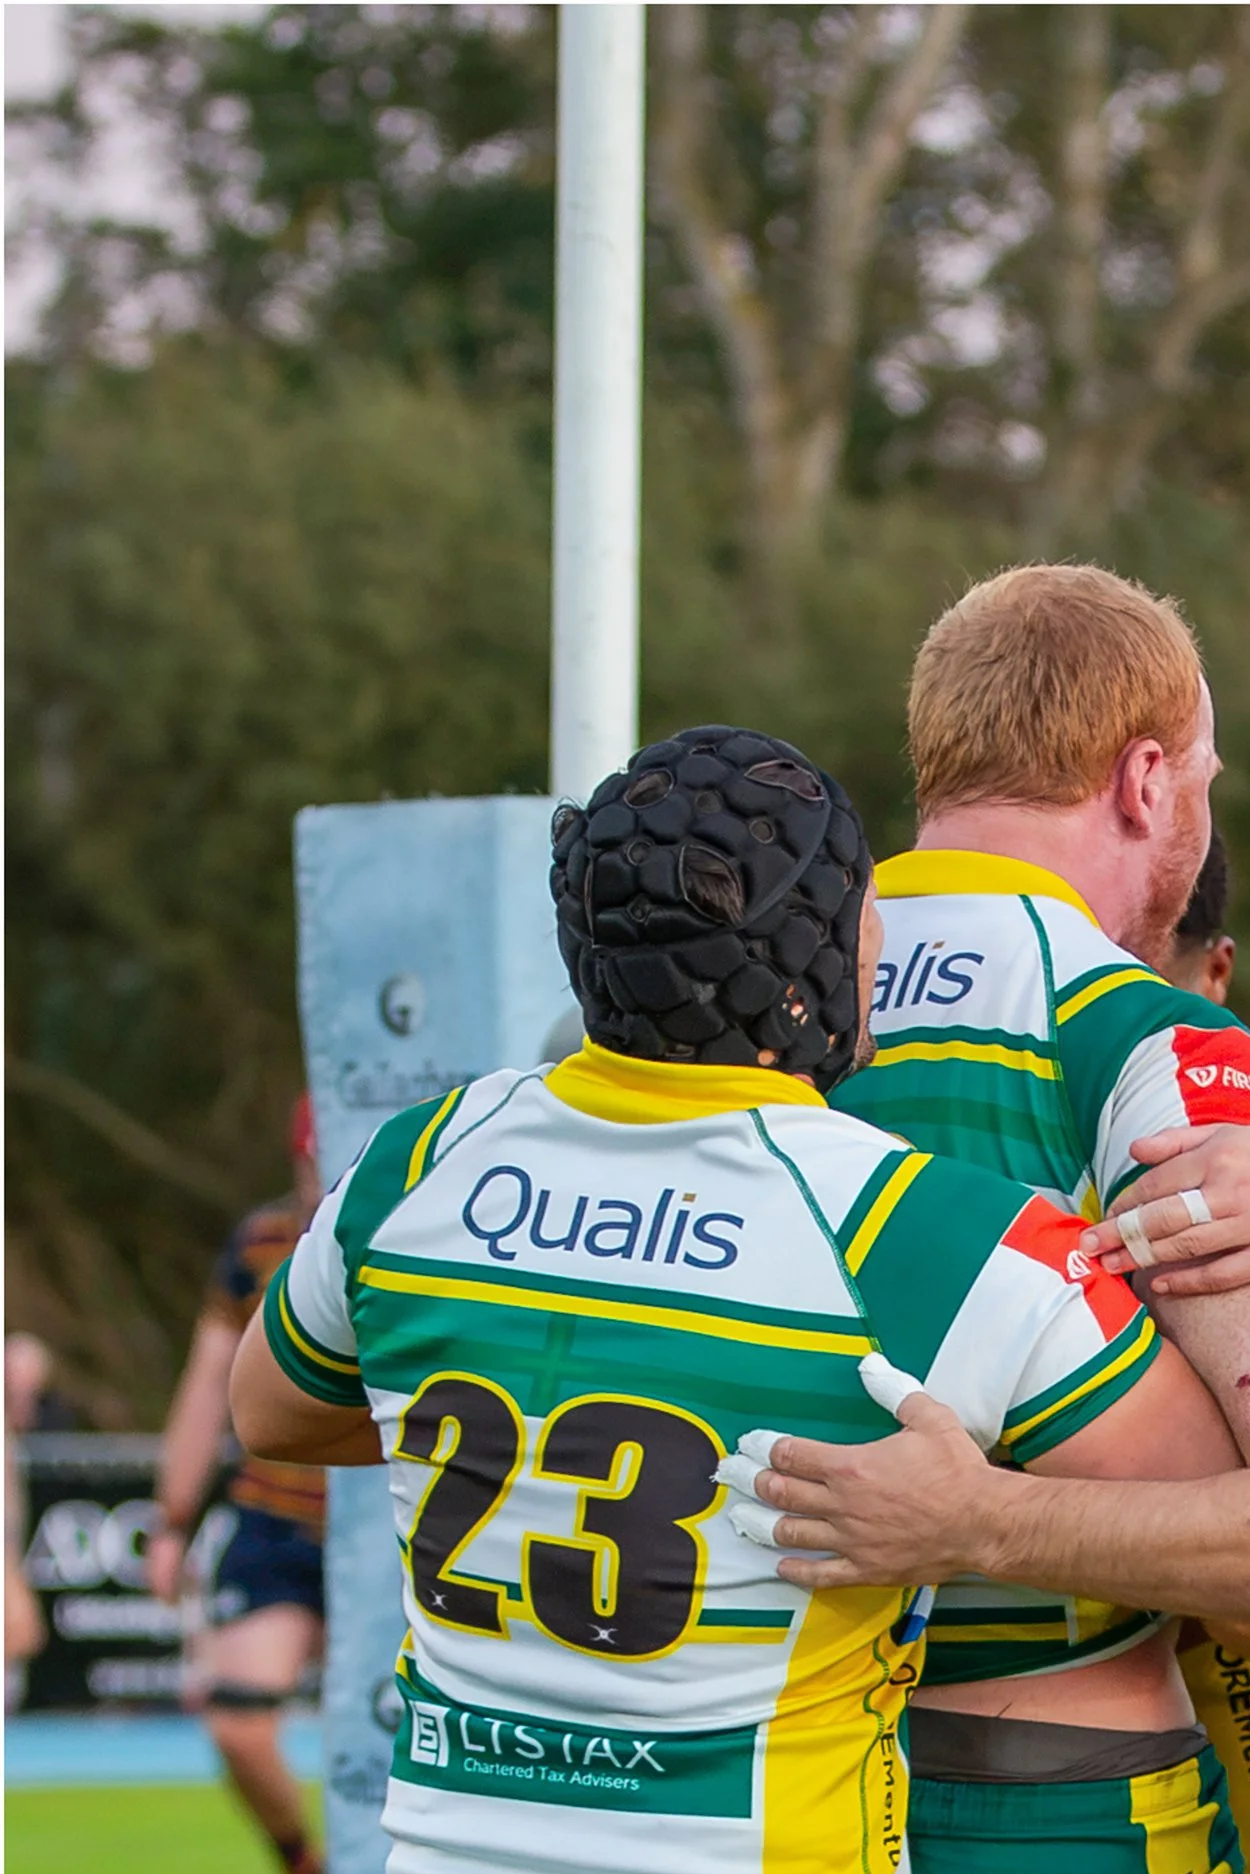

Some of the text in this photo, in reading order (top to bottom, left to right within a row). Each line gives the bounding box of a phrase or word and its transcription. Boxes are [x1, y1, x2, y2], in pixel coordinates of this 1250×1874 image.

[871, 940, 985, 1012] alis
[461, 1164, 746, 1270] Qualis
[393, 1370, 729, 1663] 23
[463, 1757, 640, 1791] Chartered Tax Advisers
